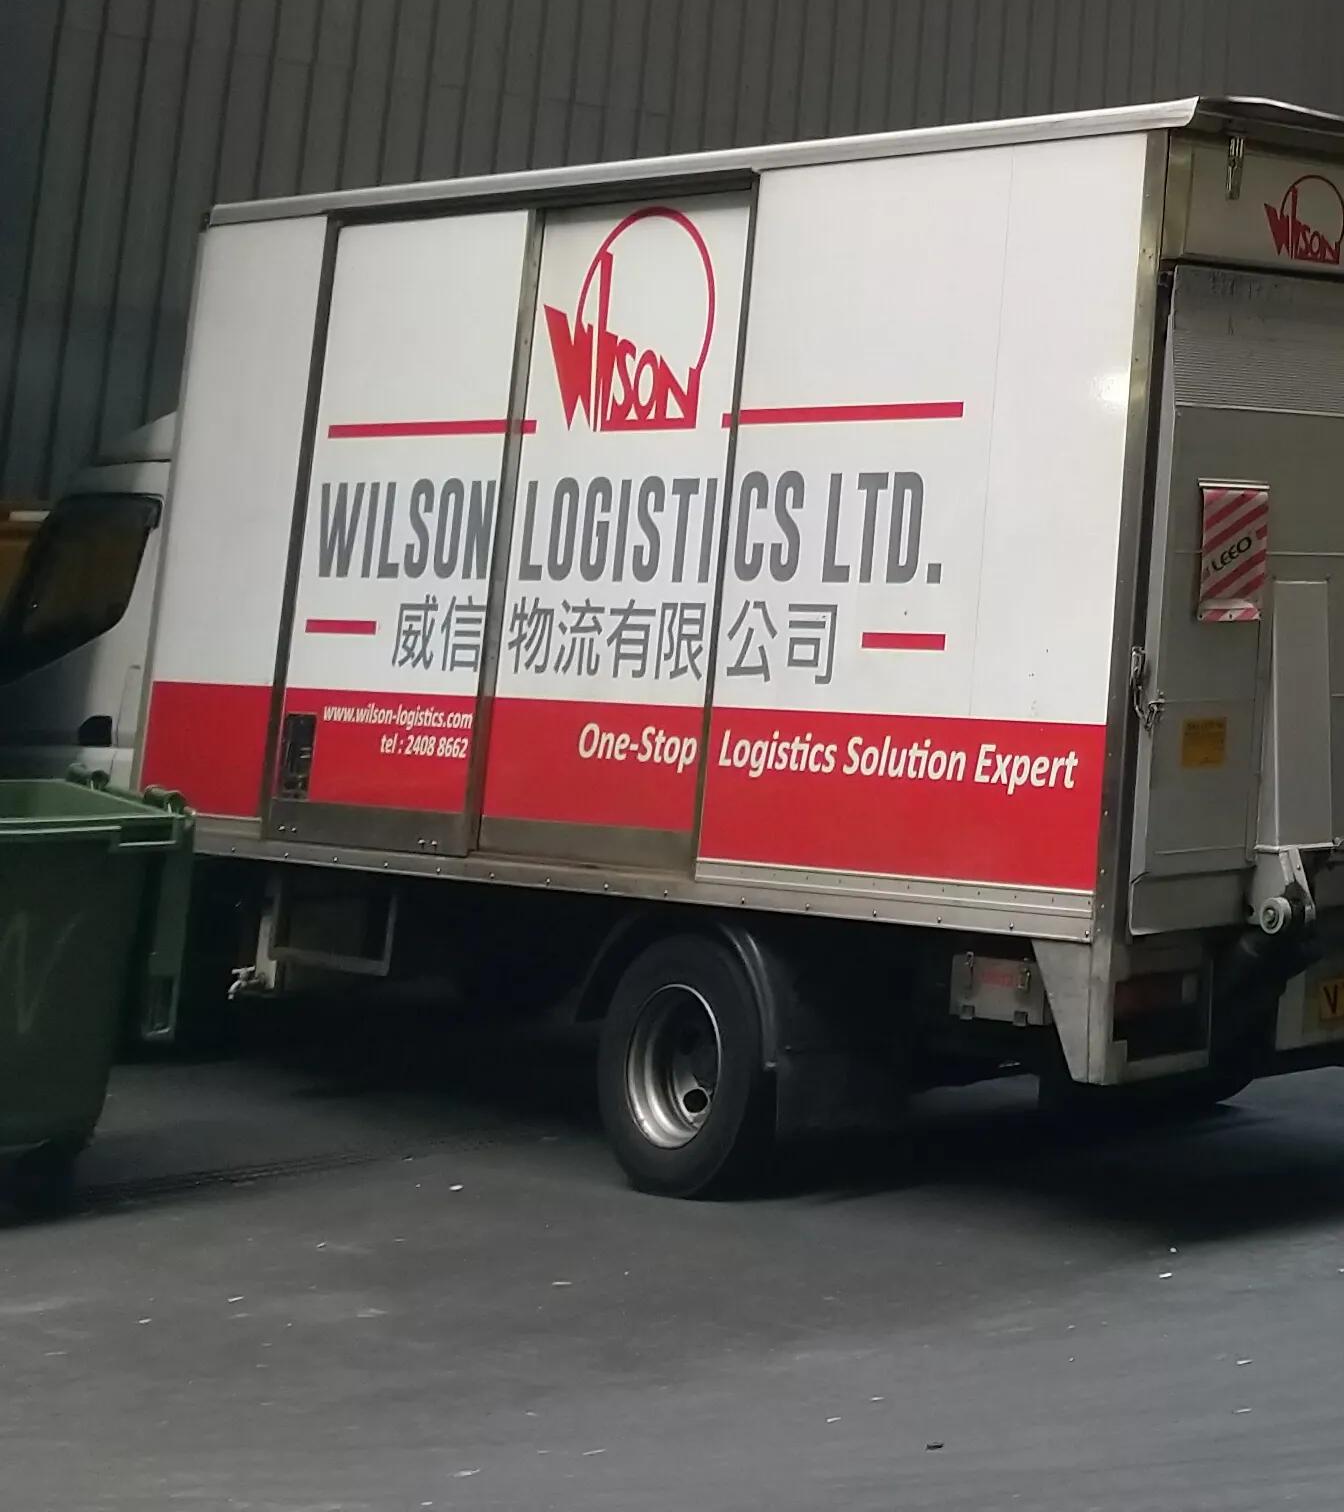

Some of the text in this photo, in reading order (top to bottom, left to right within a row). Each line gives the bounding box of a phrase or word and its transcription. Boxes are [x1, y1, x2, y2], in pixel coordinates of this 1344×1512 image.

[318, 469, 944, 586] WILSON LOGISTICS LTD.
[1212, 536, 1253, 572] LEEO
[392, 594, 839, 685] 威信物流有限公司
[323, 703, 473, 731] www.wilson-logistics.com
[405, 735, 435, 757] 2408
[437, 736, 468, 759] 8662
[577, 723, 1079, 794] One-Stop Logistics Solution Expert
